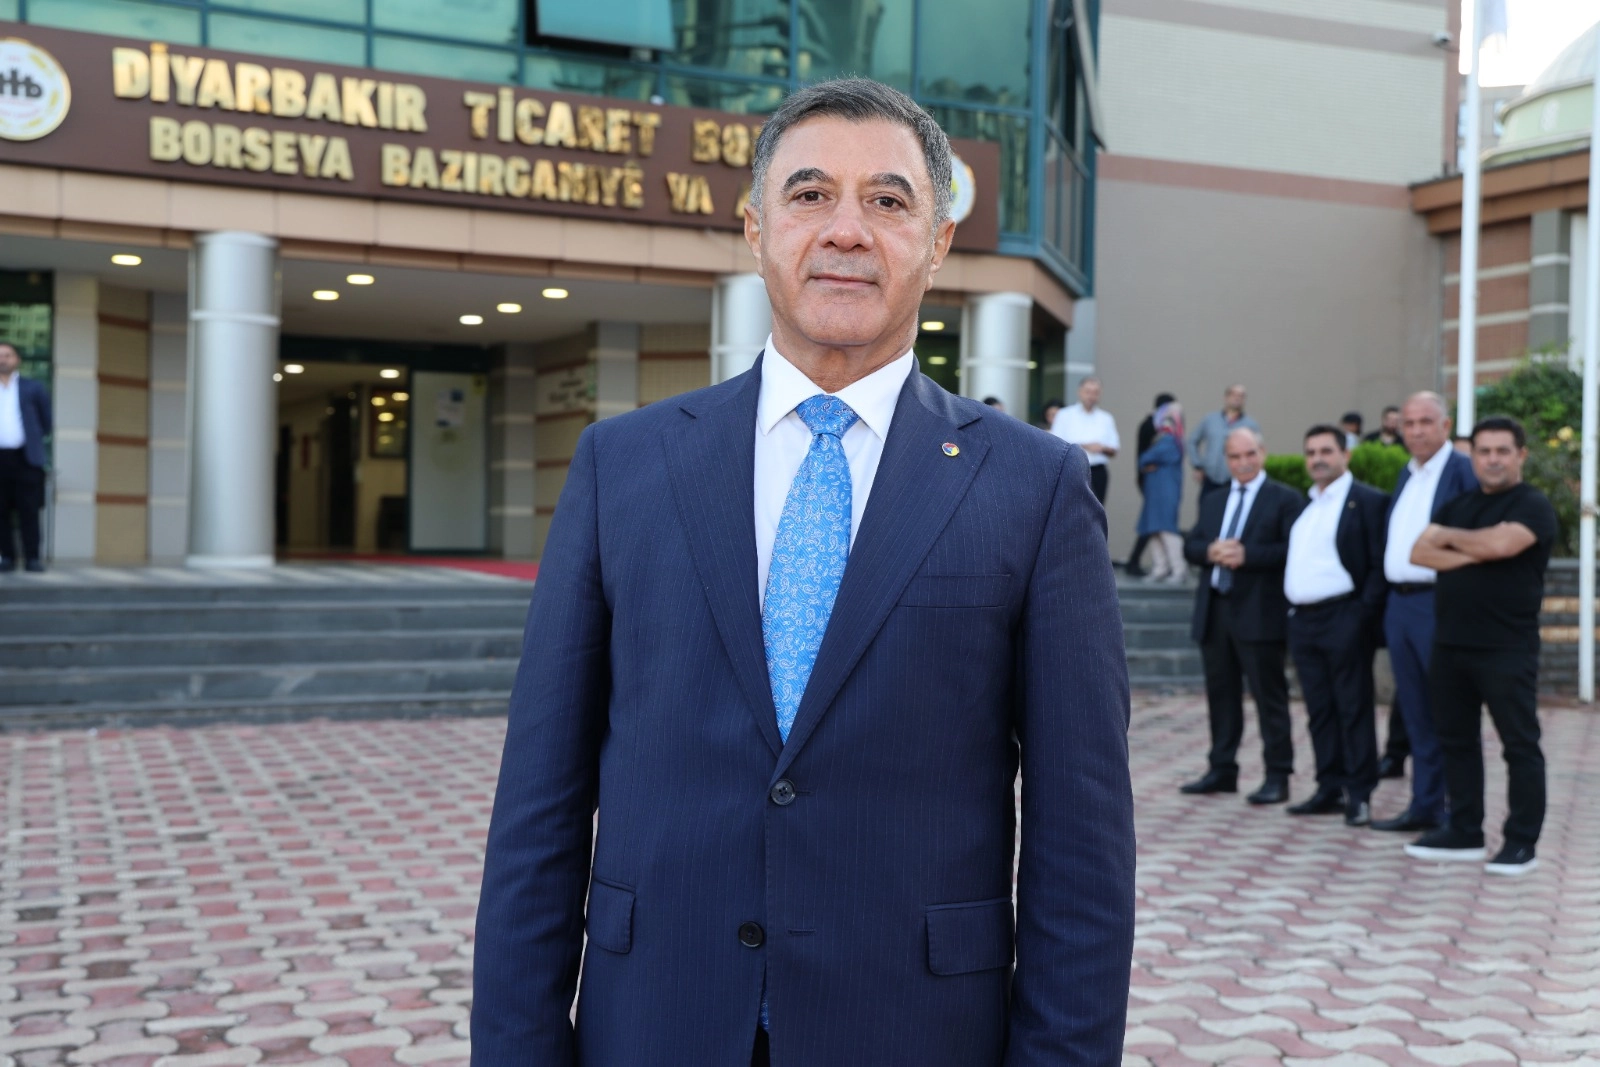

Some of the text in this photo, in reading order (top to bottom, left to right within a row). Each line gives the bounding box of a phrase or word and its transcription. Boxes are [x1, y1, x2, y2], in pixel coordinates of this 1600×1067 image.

[112, 43, 427, 132] DİYARBAKIR
[464, 87, 661, 156] TİCARET
[150, 116, 354, 181] BORSEYA
[666, 171, 714, 214] YA
